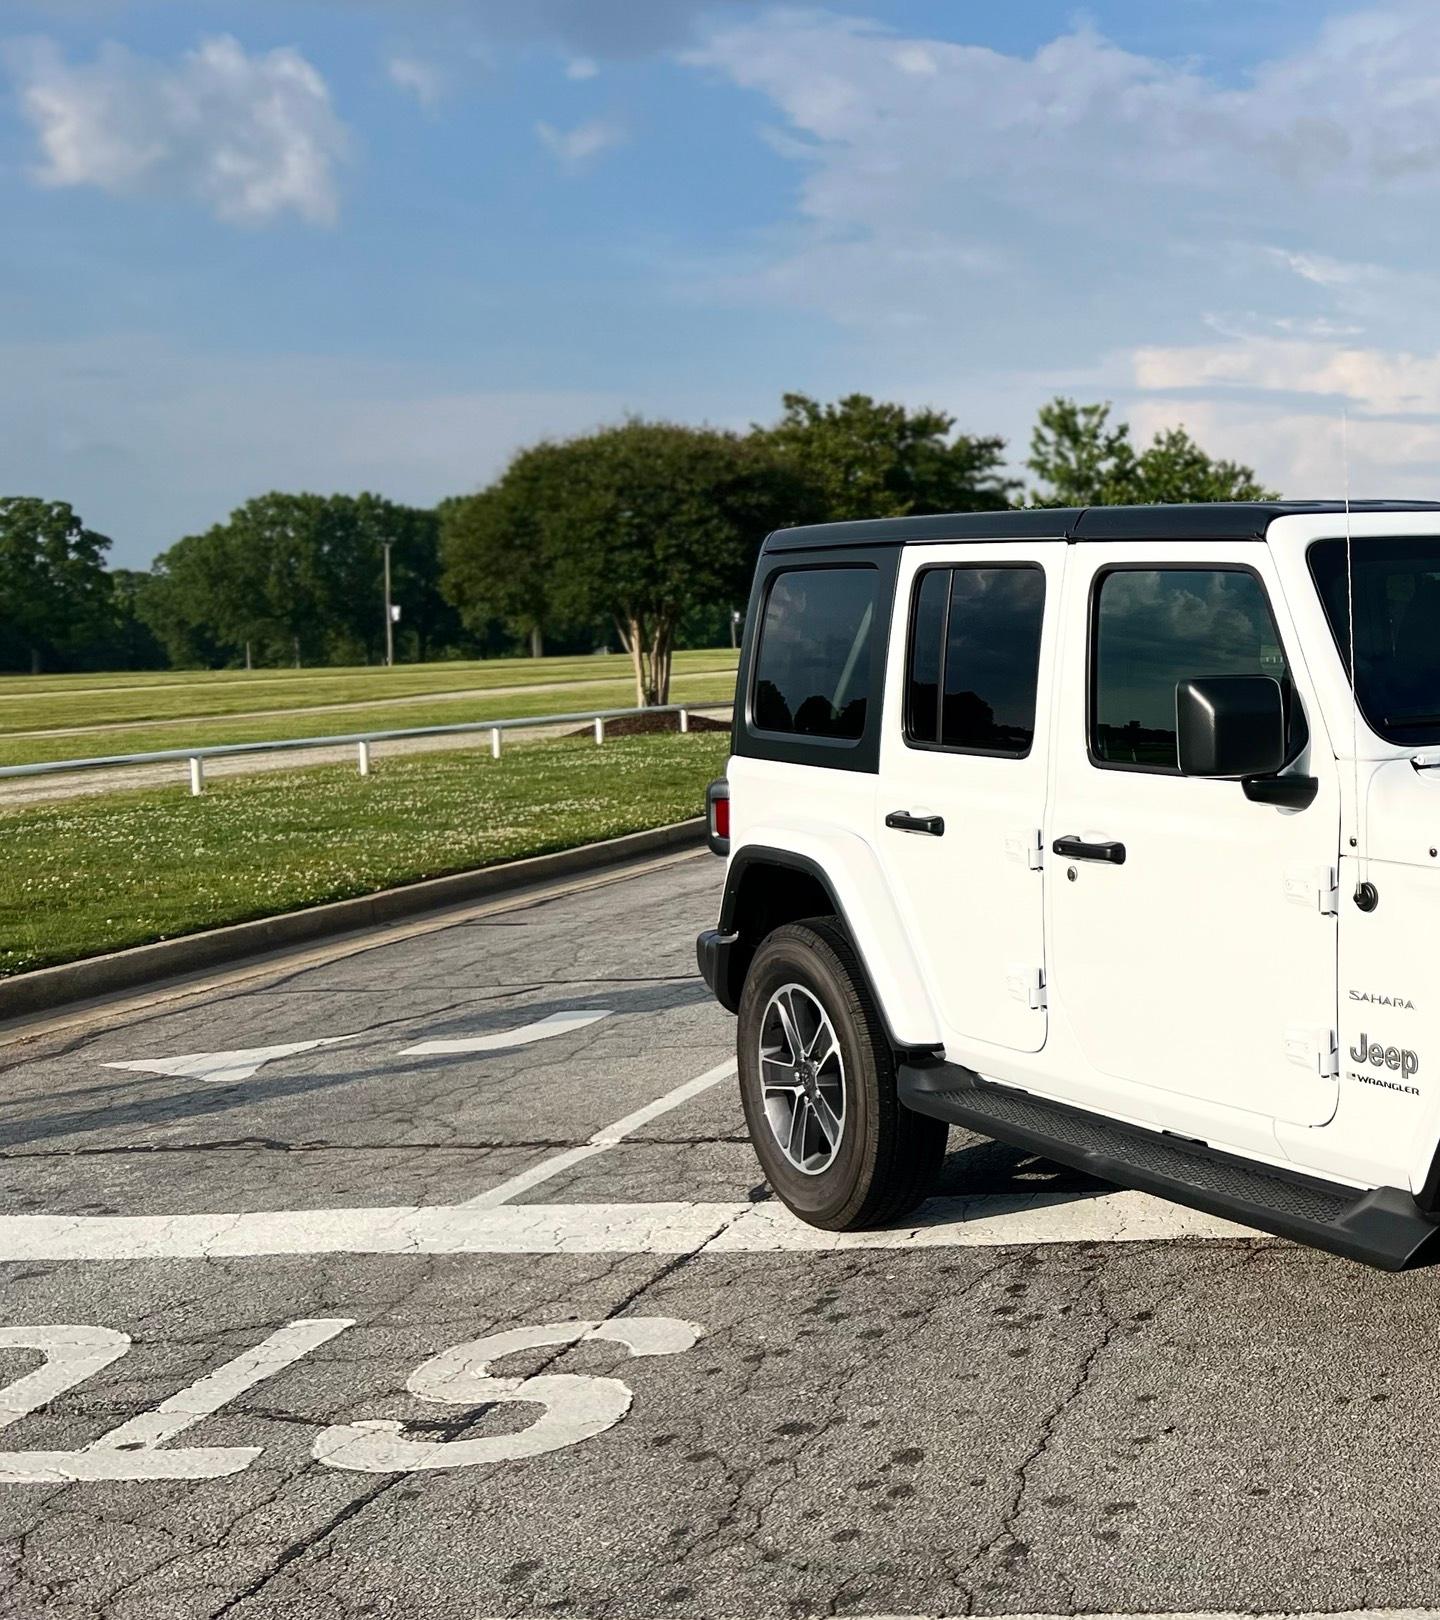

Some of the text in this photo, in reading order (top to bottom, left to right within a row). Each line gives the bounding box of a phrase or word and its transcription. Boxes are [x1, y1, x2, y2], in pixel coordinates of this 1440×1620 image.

[1349, 990, 1415, 1010] SAHARA
[1350, 1033, 1418, 1079] Jeep
[1357, 1074, 1420, 1096] WRANGLER
